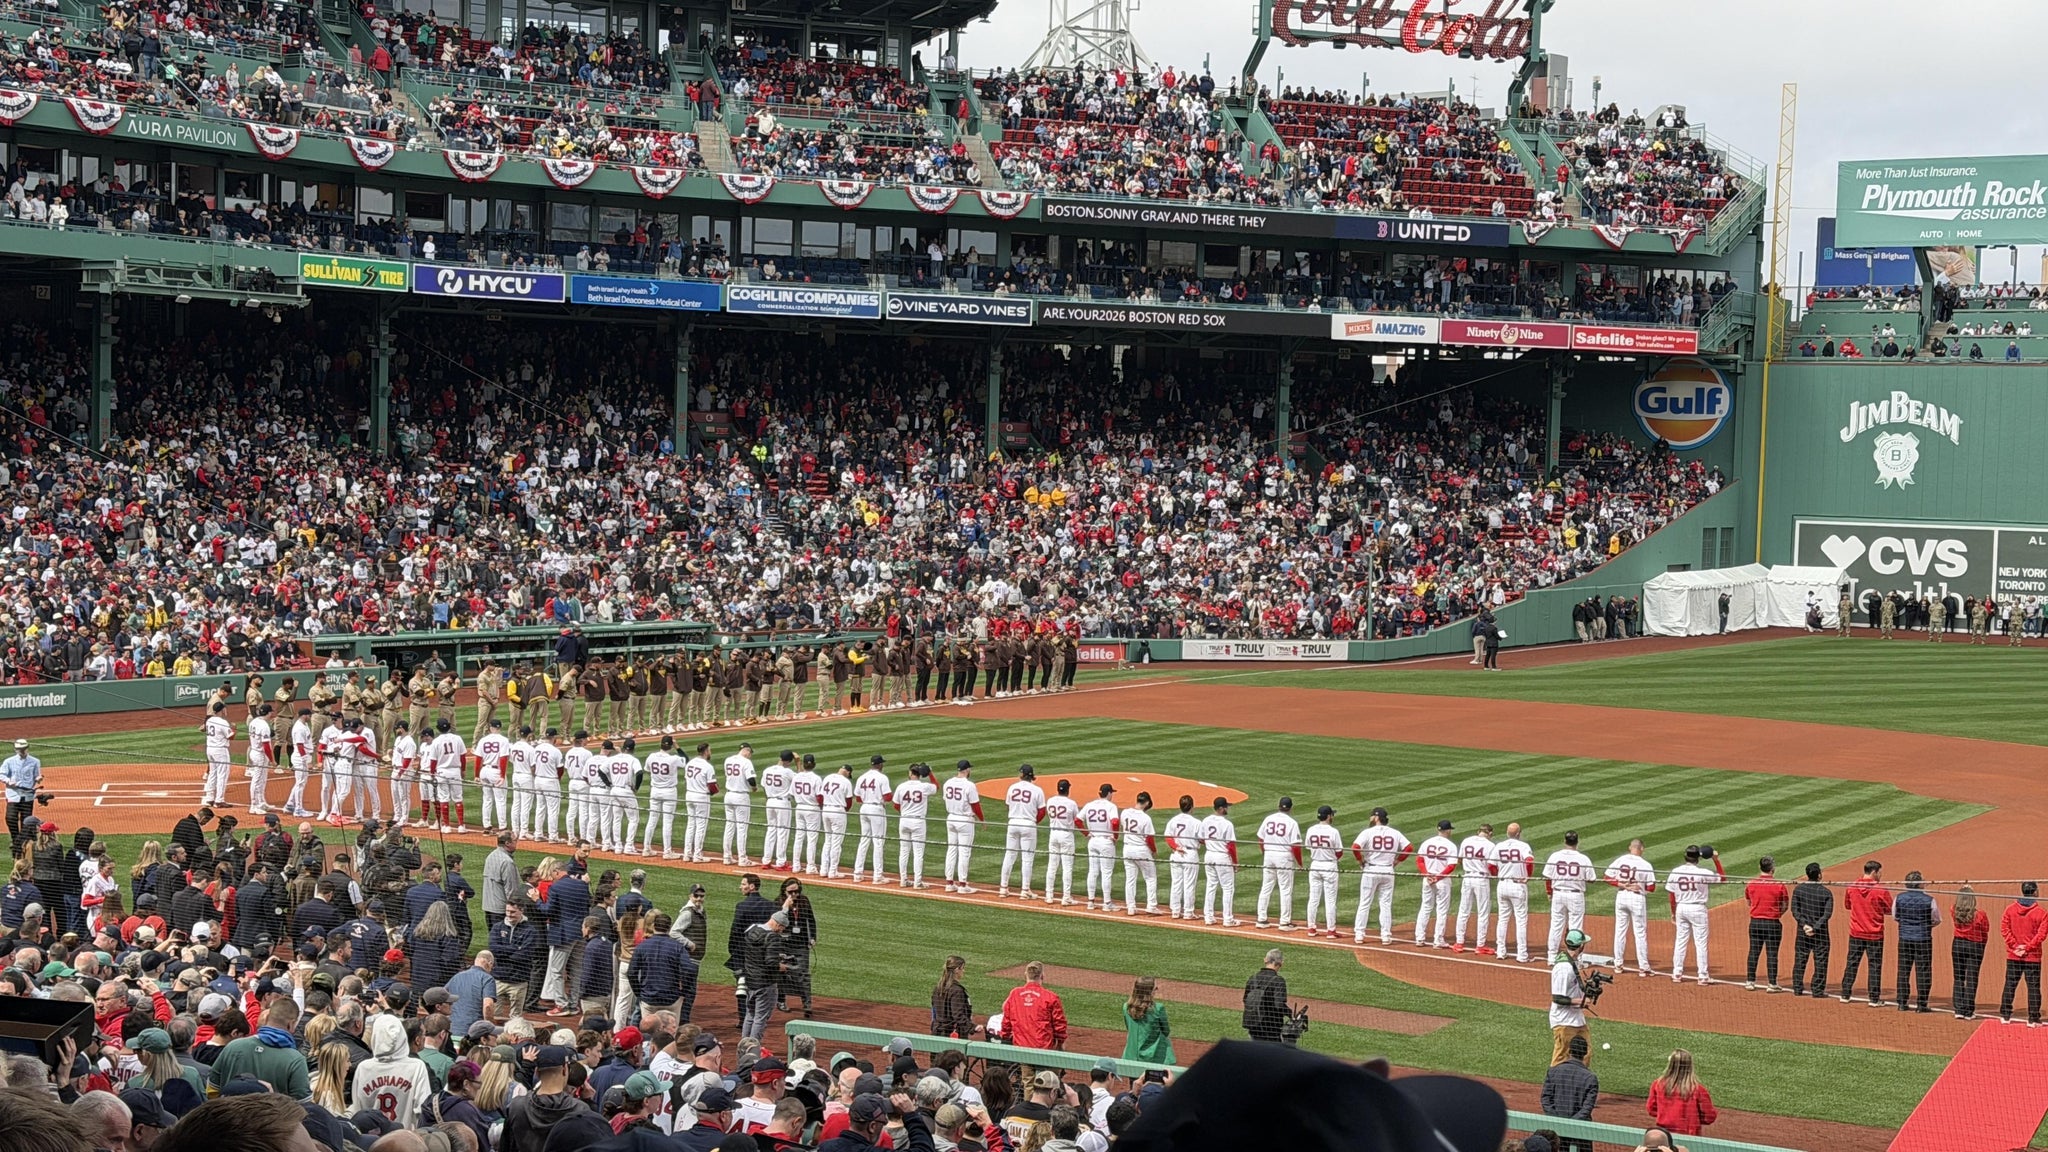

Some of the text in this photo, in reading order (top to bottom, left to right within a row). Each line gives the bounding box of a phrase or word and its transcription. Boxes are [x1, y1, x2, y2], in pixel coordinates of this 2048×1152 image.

[176, 125, 236, 147] PAVILION
[1856, 166, 1978, 179] More Than Just Insurance.
[1862, 180, 2048, 212] Plymouth Rock
[1961, 206, 2046, 221] assurance
[1201, 213, 1234, 227] THERE
[1237, 214, 1266, 228] THEY
[1398, 223, 1471, 241] UNITED
[1881, 252, 1909, 261] Brigham
[303, 260, 404, 286] SULLIVAN TIRE
[469, 274, 531, 294] HYCU
[614, 286, 630, 295] Lahey
[38, 288, 48, 297] 27
[731, 289, 878, 306] COGHLIN COMPANIES
[588, 294, 702, 307] Beth Israel Deaconess Medical Center
[904, 300, 1027, 317] VINEYARD VINES
[1129, 312, 1176, 326] BOSTON
[1178, 313, 1201, 326] RED
[1203, 314, 1226, 327] SOX
[1348, 323, 1426, 335] MIKE'S AMAZING
[1467, 326, 1543, 340] Ninety 99 Nine
[1576, 332, 1634, 346] Safelite
[1638, 386, 1722, 414] Gulf
[1840, 390, 1960, 446] JIM BEAM
[1892, 450, 1901, 461] B
[1868, 536, 1968, 578] CVS
[1999, 567, 2047, 578] NEW YORK
[1998, 580, 2045, 591] TORONTO
[1076, 648, 1114, 660] felite
[1234, 644, 1264, 654] TRULY
[1301, 644, 1331, 654] TRULY
[326, 673, 340, 683] city
[178, 686, 237, 700] ACE TICT
[0, 693, 66, 708] smartwater
[444, 742, 454, 754] 11
[536, 750, 548, 763] 76
[568, 756, 579, 767] 71
[589, 764, 600, 776] 6
[612, 762, 628, 774] 66
[651, 762, 669, 775] 63
[687, 766, 702, 778] 57
[726, 764, 740, 776] 56
[766, 774, 782, 787] 55
[860, 779, 876, 790] 44
[794, 782, 811, 794] 50
[823, 782, 840, 794] 47
[946, 788, 962, 800] 35
[902, 790, 922, 803] 43
[1012, 789, 1032, 803] 29
[1048, 806, 1067, 819] 32
[1088, 809, 1107, 822] 23
[1125, 818, 1138, 833] 12
[1176, 824, 1186, 836] 7
[1208, 826, 1217, 838] 2
[1266, 822, 1286, 836] 33
[1309, 835, 1330, 848] 85
[1372, 836, 1394, 850] 88
[1426, 845, 1448, 859] 62
[1464, 845, 1484, 859] 84
[1498, 849, 1520, 862] 58
[1556, 860, 1580, 876] 60
[363, 1076, 413, 1096] MADHAPPY
